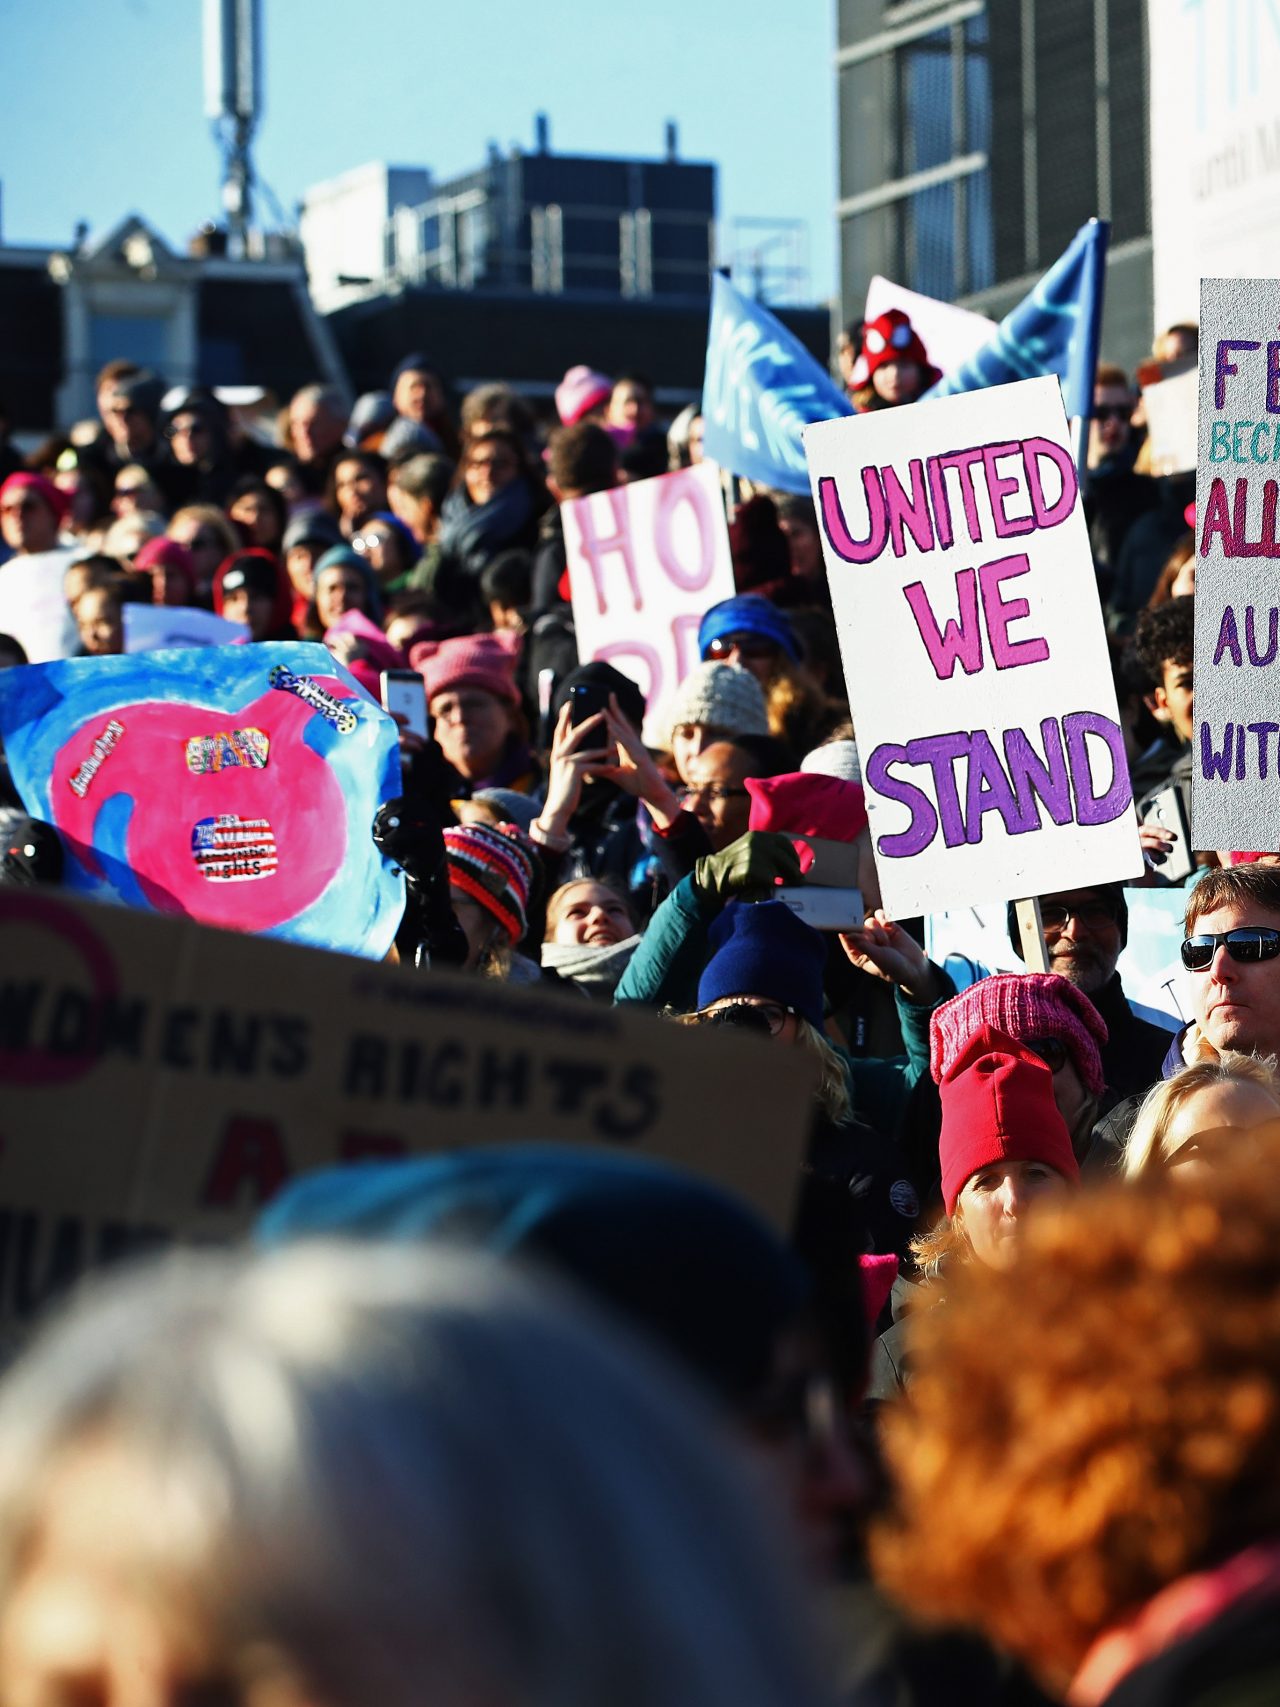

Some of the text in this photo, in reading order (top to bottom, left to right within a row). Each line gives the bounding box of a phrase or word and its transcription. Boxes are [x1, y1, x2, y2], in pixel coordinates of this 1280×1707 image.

[819, 436, 1078, 565] UNITED
[902, 553, 1050, 680] WE
[865, 710, 1132, 858] STAND
[342, 1033, 664, 1138] RIGHTS
